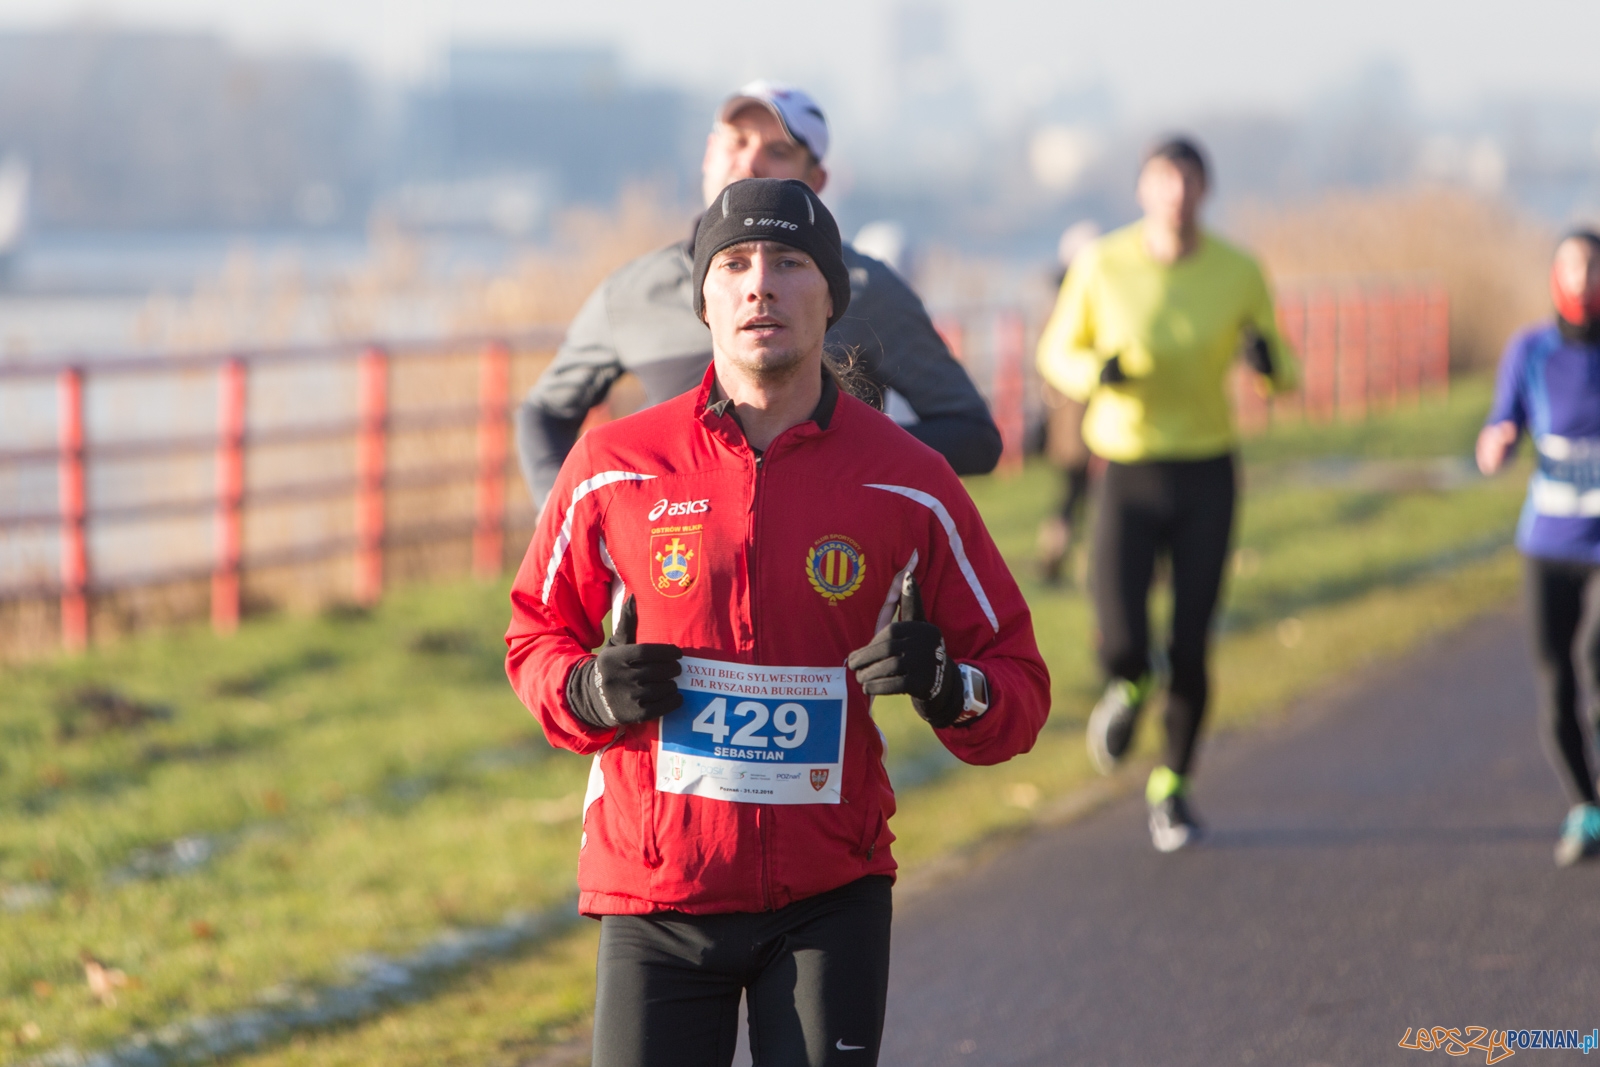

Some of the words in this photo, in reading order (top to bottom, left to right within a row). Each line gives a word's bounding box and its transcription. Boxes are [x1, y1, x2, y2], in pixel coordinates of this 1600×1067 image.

[756, 217, 798, 231] HI-TEC
[667, 499, 709, 516] asics
[651, 526, 681, 534] OSTRÓW
[829, 533, 862, 550] SPORTOWY
[816, 543, 858, 563] MARATON
[686, 664, 715, 677] XXXII
[718, 669, 744, 680] BIEG
[747, 673, 832, 683] SYLWESTROWY
[690, 677, 707, 688] IM.
[709, 682, 768, 695] RYSZARDA
[771, 686, 828, 696] BURGIELA
[691, 696, 810, 749] 429
[714, 746, 784, 761] SEBASTIAN
